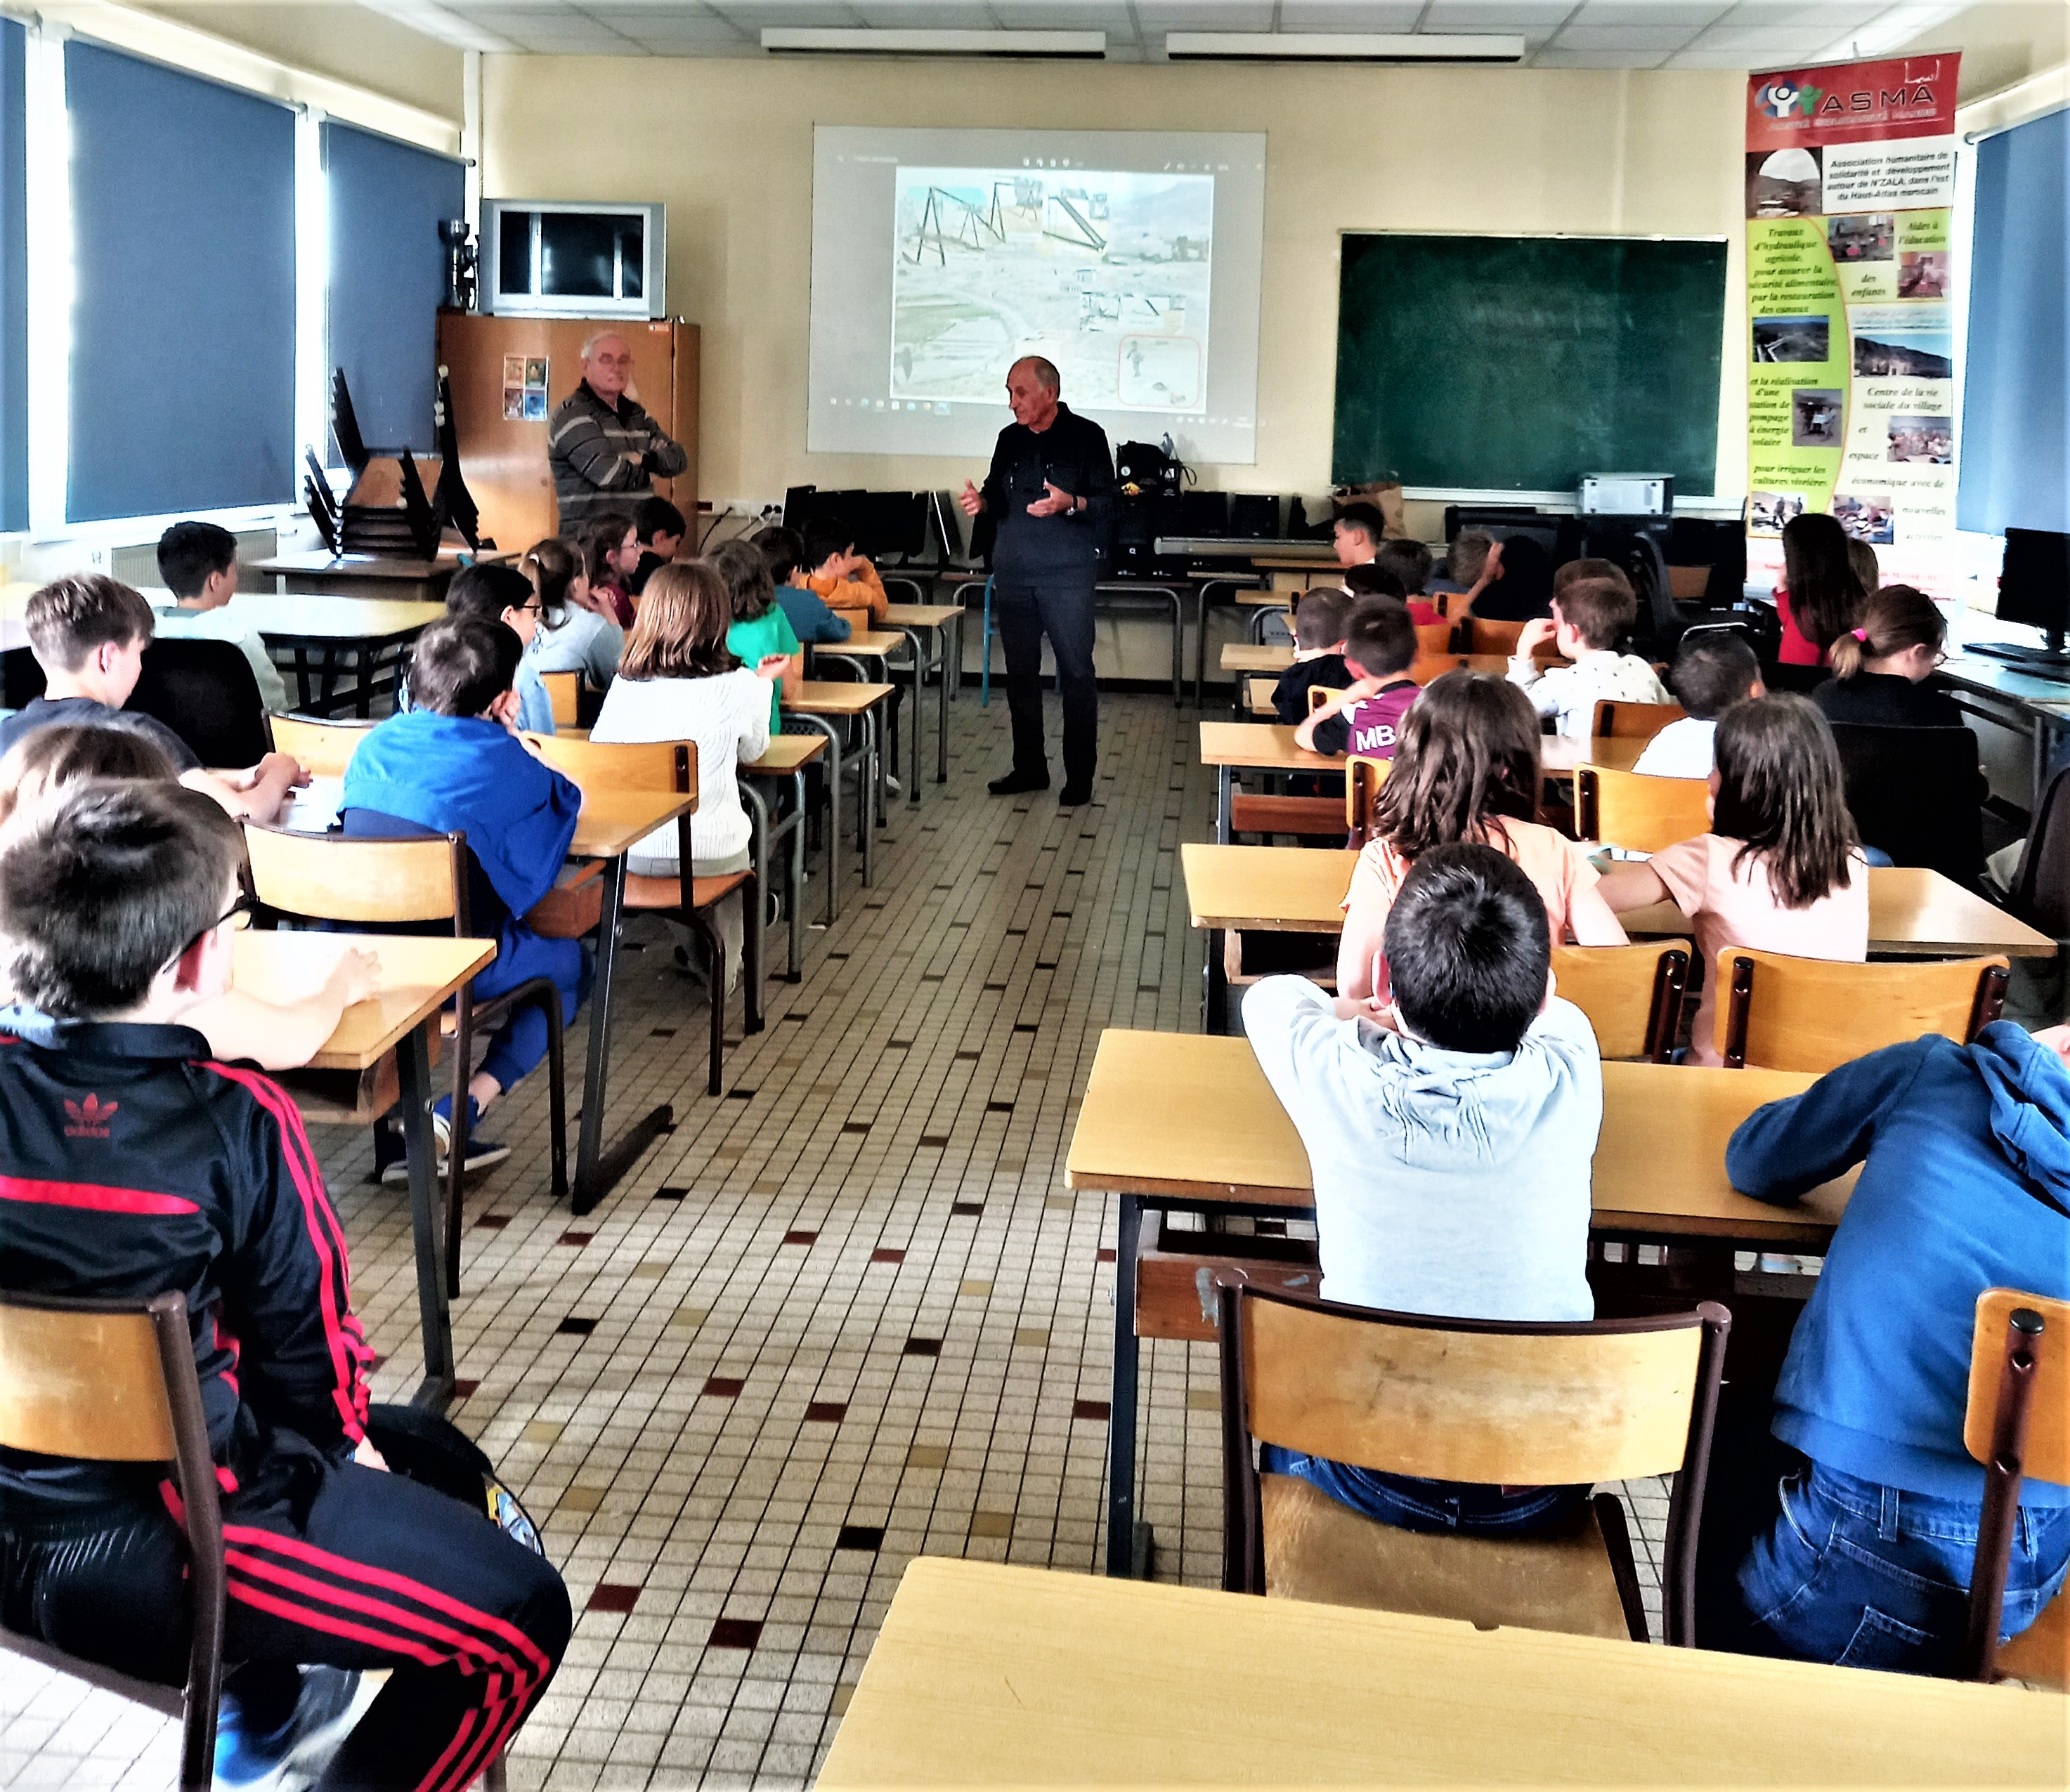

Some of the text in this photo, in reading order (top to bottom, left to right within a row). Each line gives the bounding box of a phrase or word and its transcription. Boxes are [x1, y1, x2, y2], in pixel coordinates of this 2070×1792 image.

[1821, 85, 1934, 115] ASMA
[1831, 159, 1882, 168] Association
[1886, 152, 1935, 164] humanitaire
[1829, 169, 1869, 179] solidarité
[1827, 182, 1854, 190] autour
[1908, 176, 1929, 185] dans
[1861, 274, 1877, 283] des
[1851, 287, 1887, 299] enfants
[1867, 387, 1898, 396] Centre
[1901, 388, 1913, 396] de
[1915, 388, 1924, 396] la
[1779, 400, 1790, 409] de
[1863, 400, 1895, 410] sociale
[1898, 400, 1910, 409] du
[1849, 452, 1879, 461] espace
[1754, 465, 1776, 474] pour
[1851, 476, 1908, 488] économique
[1933, 479, 1945, 488] de
